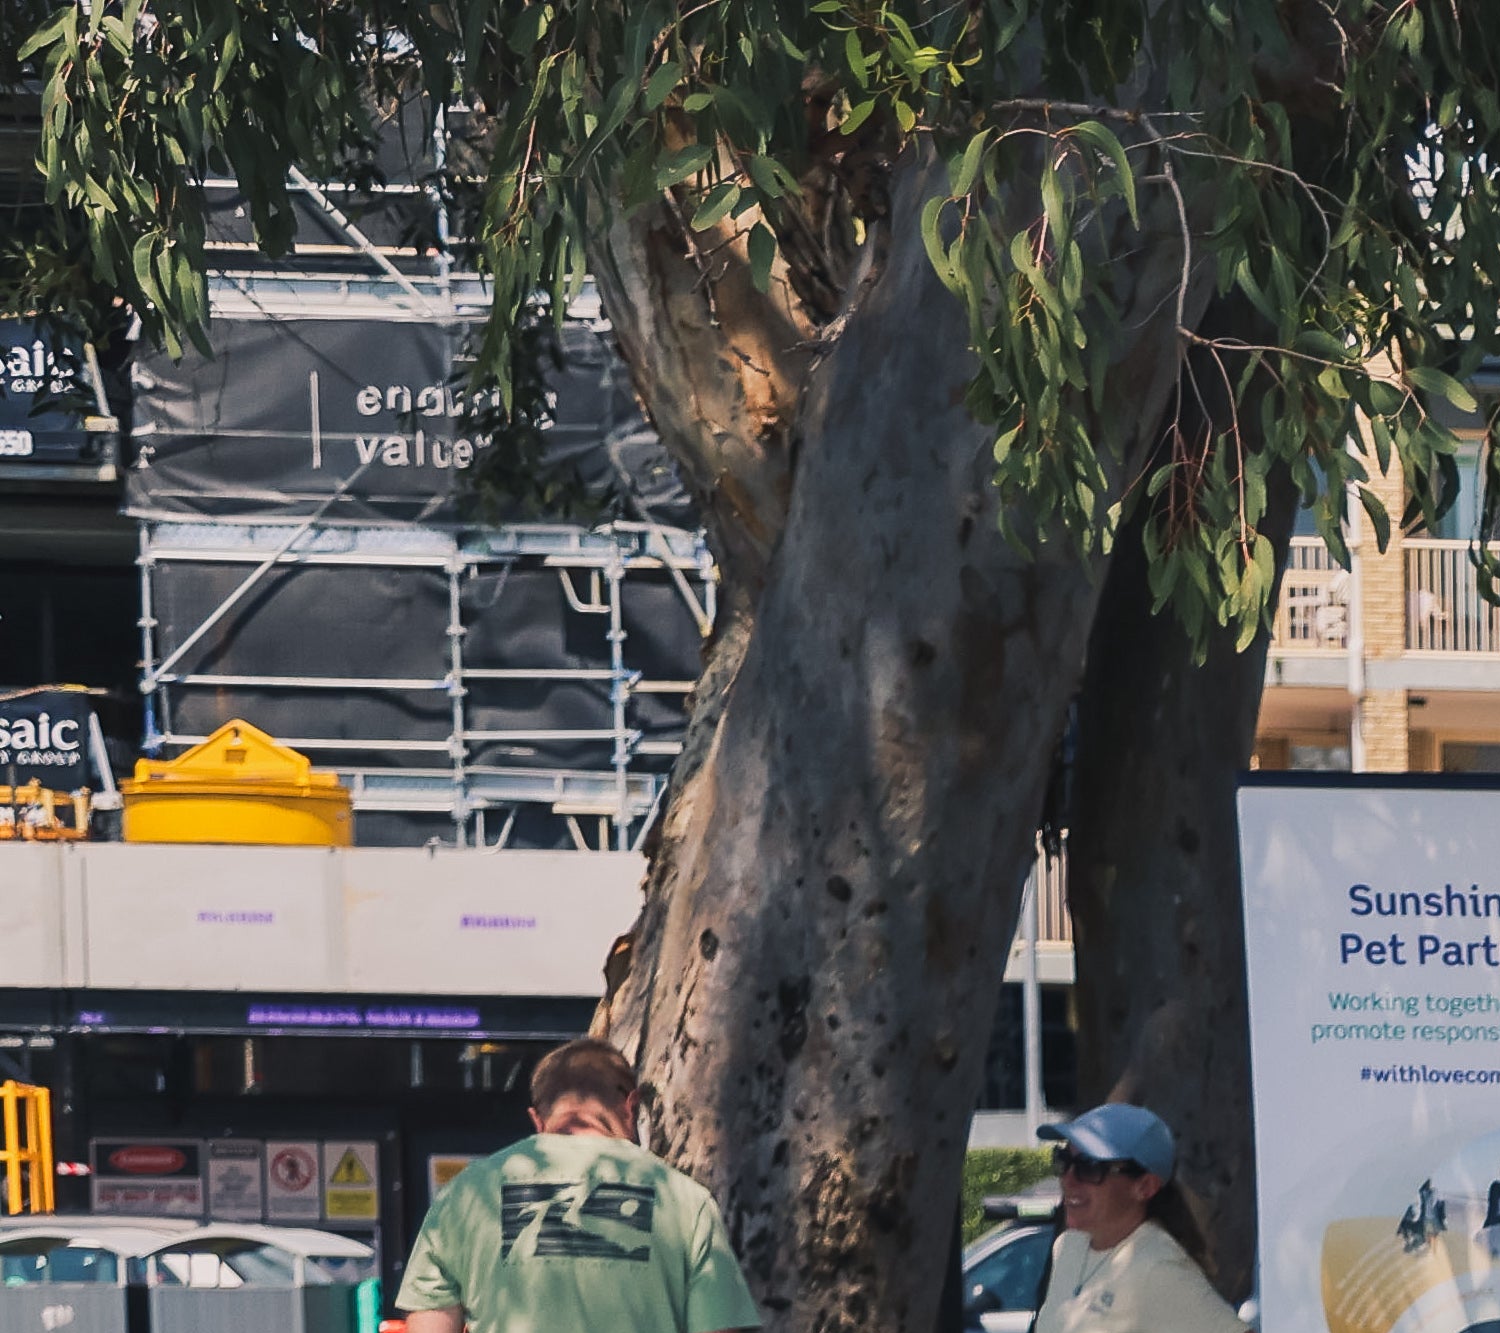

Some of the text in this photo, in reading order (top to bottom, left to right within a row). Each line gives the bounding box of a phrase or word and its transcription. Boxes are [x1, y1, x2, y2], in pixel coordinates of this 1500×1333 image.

[1339, 932, 1406, 966] Pet
[1328, 991, 1420, 1017] Working
[1311, 1022, 1406, 1043] promote
